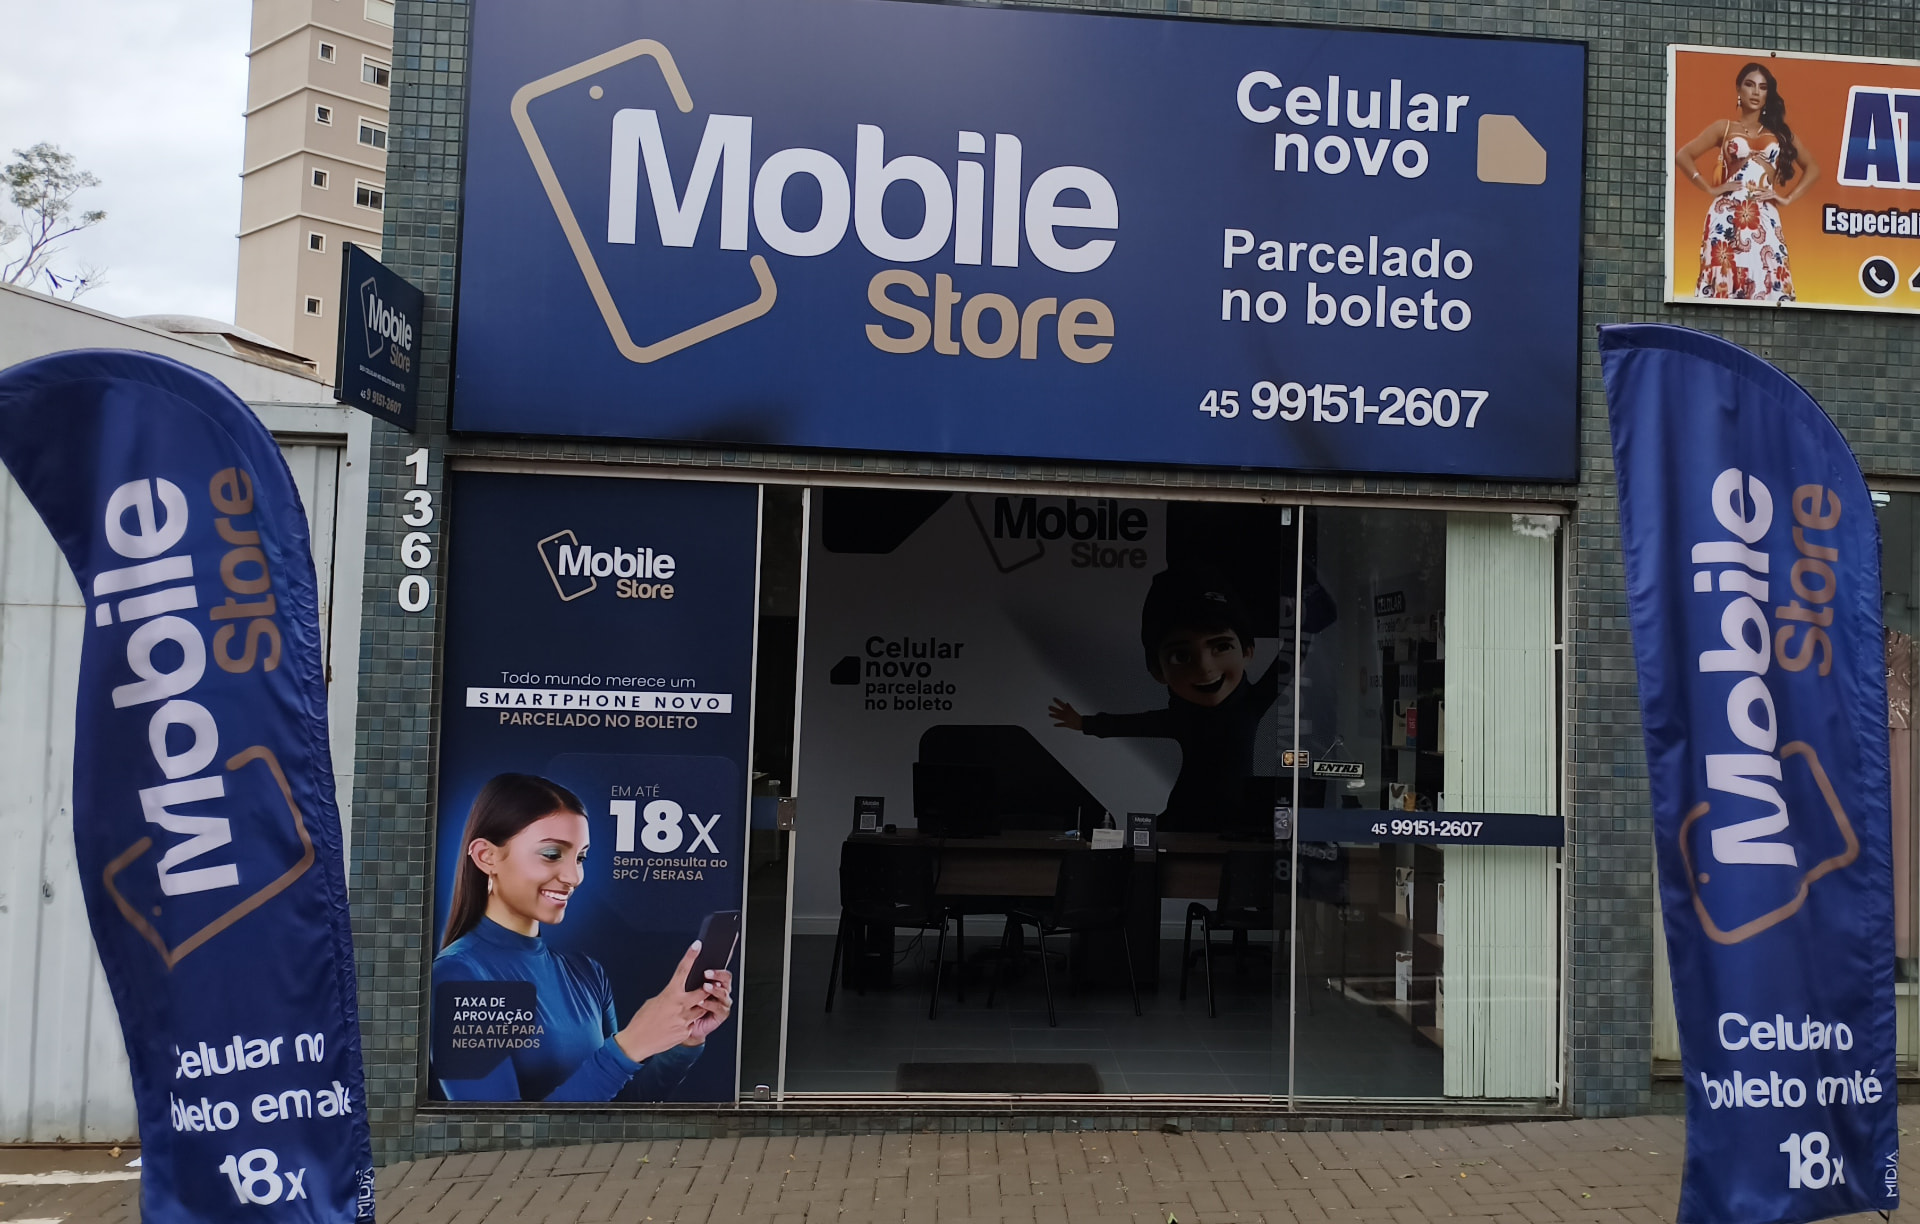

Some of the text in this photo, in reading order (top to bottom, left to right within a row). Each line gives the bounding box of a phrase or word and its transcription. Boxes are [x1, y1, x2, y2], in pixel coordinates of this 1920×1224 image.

[1236, 70, 1470, 133] Celular
[1274, 133, 1429, 178] novo
[607, 107, 1119, 273] Mobile
[1825, 207, 1920, 235] Especial
[1223, 228, 1474, 280] Parcelado
[368, 293, 412, 351] Mobile
[865, 269, 1115, 363] Store
[1221, 282, 1472, 331] no boleto
[390, 343, 411, 373] Store
[1199, 380, 1489, 428] 45 99151-2607
[398, 448, 434, 612] 1360
[994, 496, 1149, 541] Mobile
[209, 466, 282, 674] Store
[558, 545, 676, 580] Mobile
[1071, 542, 1148, 569] Store
[616, 579, 675, 600] Store
[1774, 483, 1842, 677] Store
[865, 636, 964, 660] Celular
[501, 671, 696, 688] Todo mundo merece um
[865, 658, 932, 678] novo
[1692, 467, 1798, 867] Mobile
[94, 476, 240, 897] Mobile
[479, 692, 720, 710] SMARTPHONE NOVO
[865, 680, 956, 699] parcelado
[865, 696, 953, 711] no boleto
[499, 712, 698, 729] PARCELADO NO BOLETO
[1316, 763, 1360, 774] ENTRE
[611, 783, 661, 797] EM ATÉ
[1371, 819, 1483, 837] 45 99151-2607
[612, 868, 639, 880] SPC
[652, 869, 704, 881] SERASA
[613, 855, 728, 868] Sem consulta ao
[453, 1008, 533, 1024] APROVAÇÃO
[454, 997, 506, 1008] TAXA DE
[452, 1037, 541, 1049] NEGATIVADOS
[453, 1022, 545, 1036] ALTA ATÉ PARA
[175, 1033, 324, 1079] elular no
[251, 1089, 312, 1123] em
[1701, 1070, 1807, 1110] boleto
[1779, 1131, 1846, 1190] 18x
[219, 1148, 307, 1206] 18x
